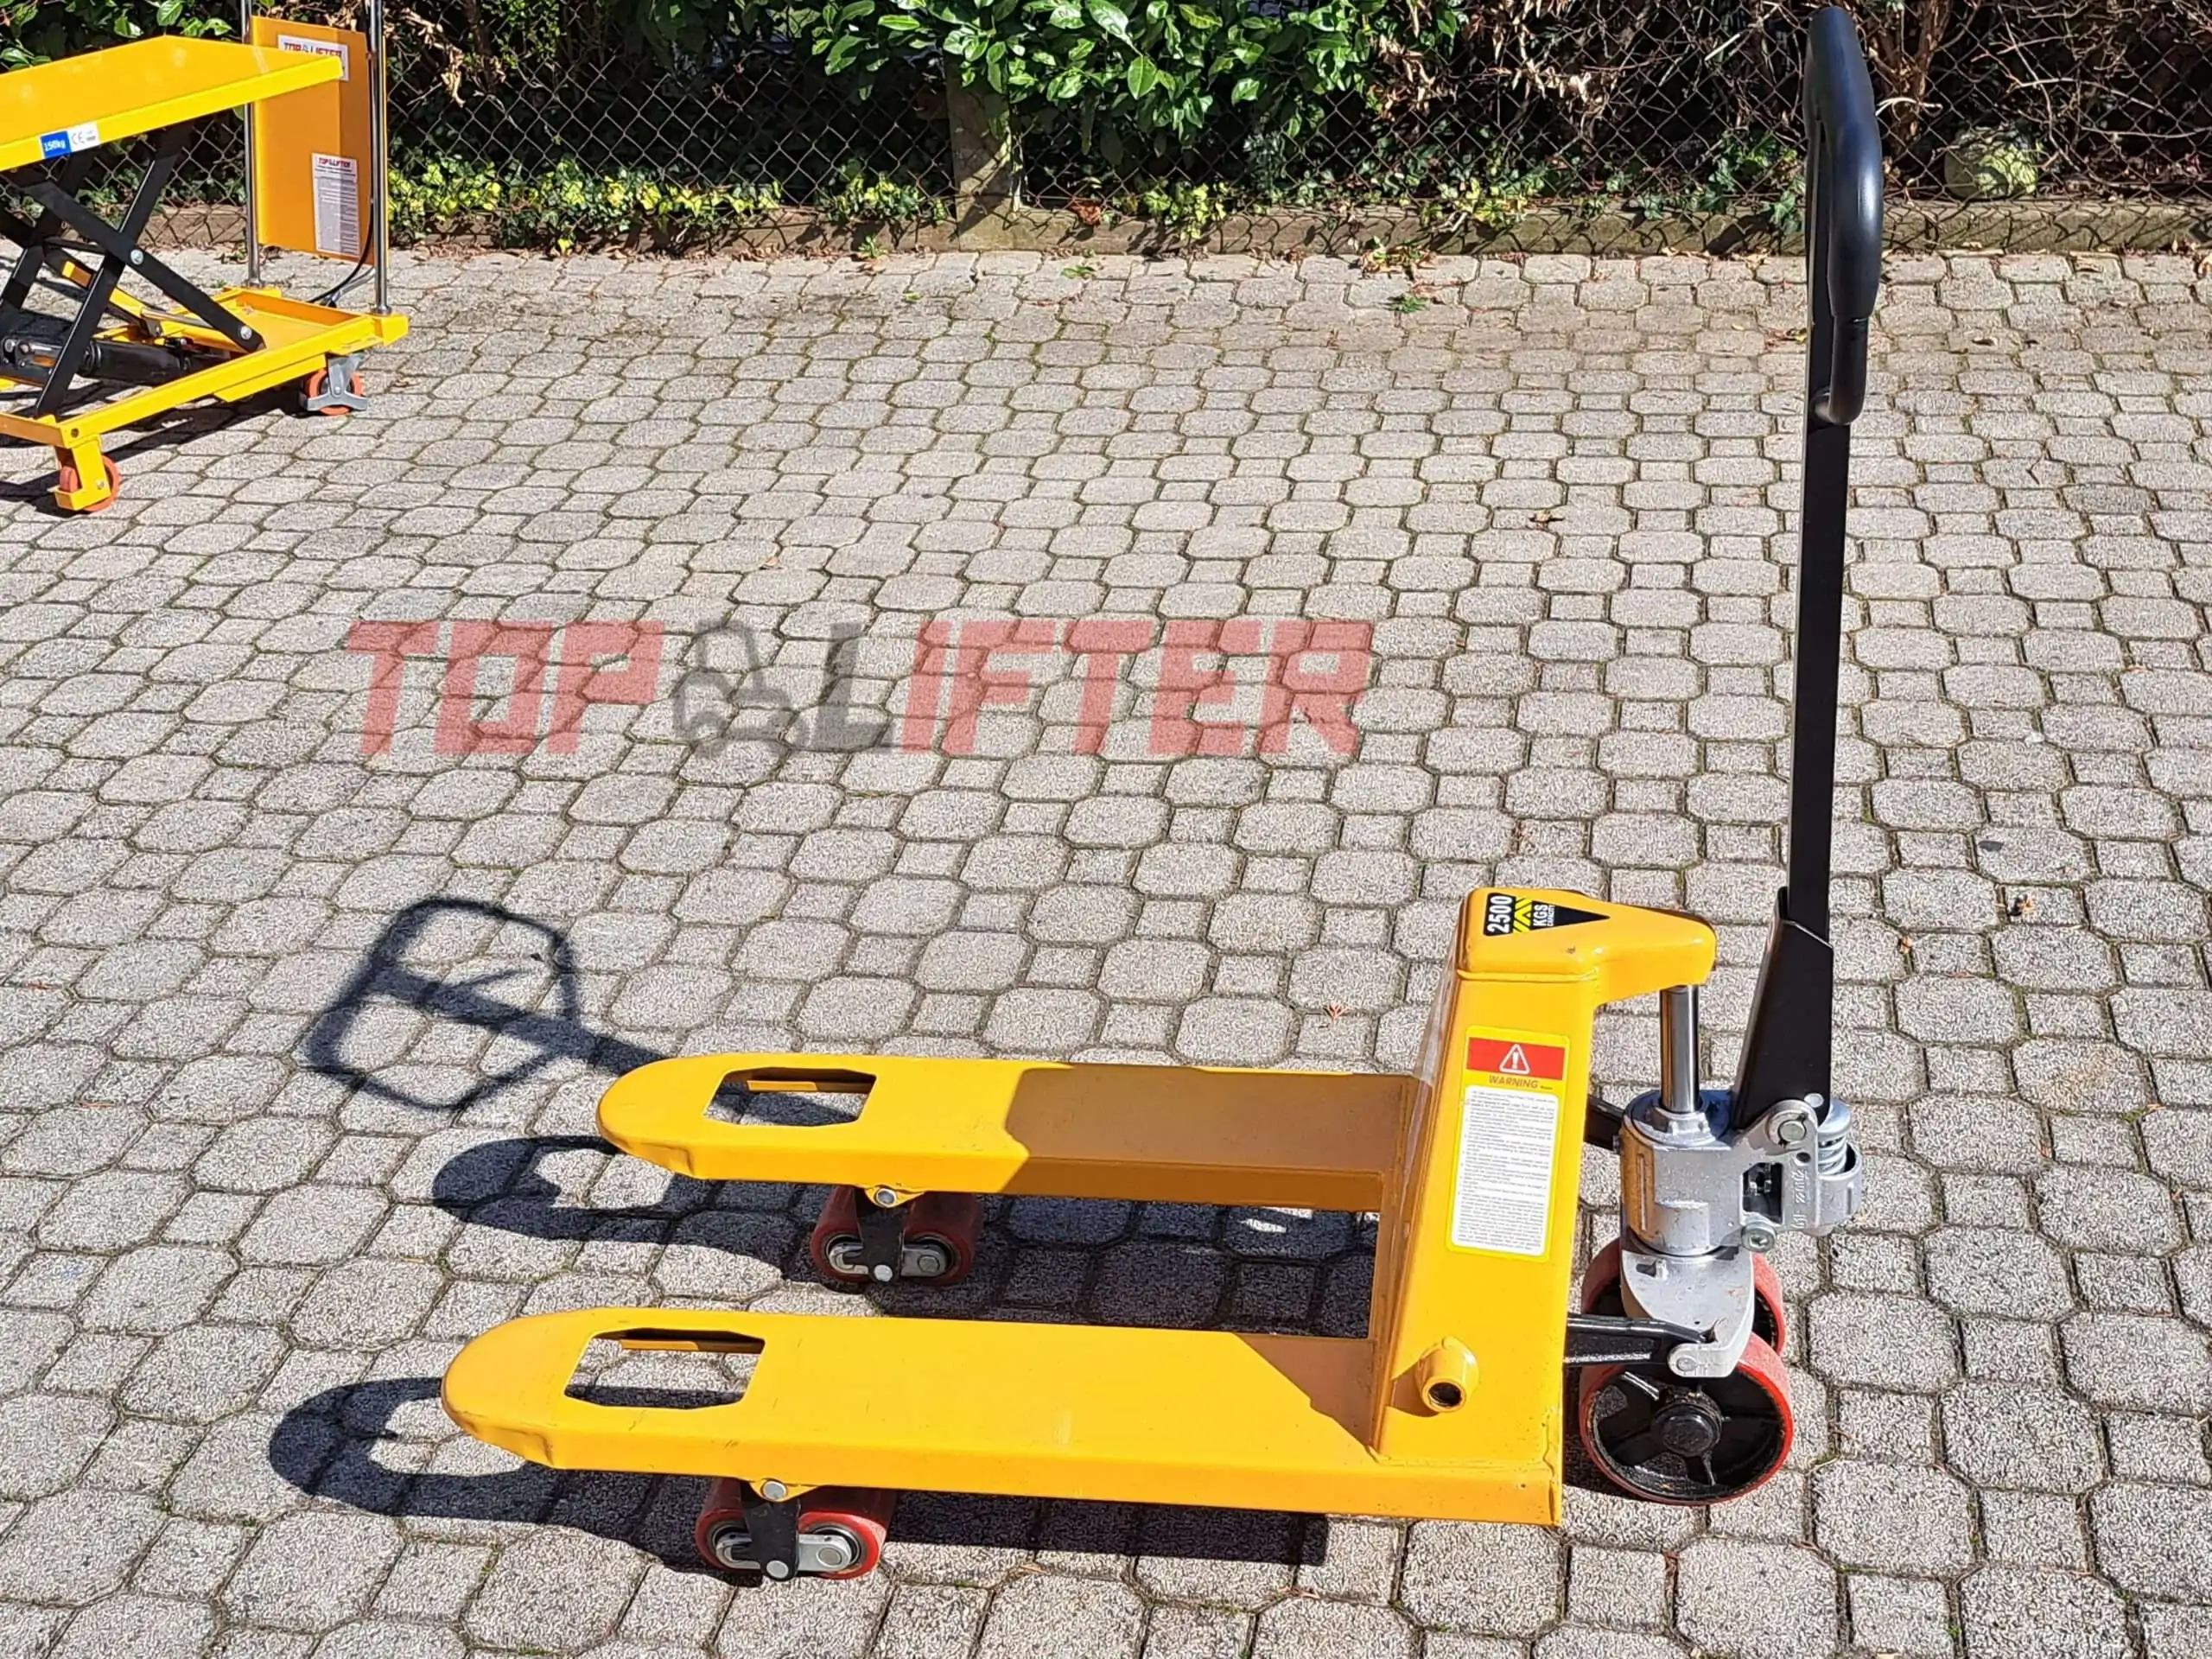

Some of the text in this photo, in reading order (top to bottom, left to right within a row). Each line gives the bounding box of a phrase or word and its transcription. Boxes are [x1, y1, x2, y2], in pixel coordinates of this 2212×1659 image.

[1486, 894, 1513, 934] 2500
[1532, 904, 1548, 927] KGS
[1489, 1074, 1540, 1089] WARNING
